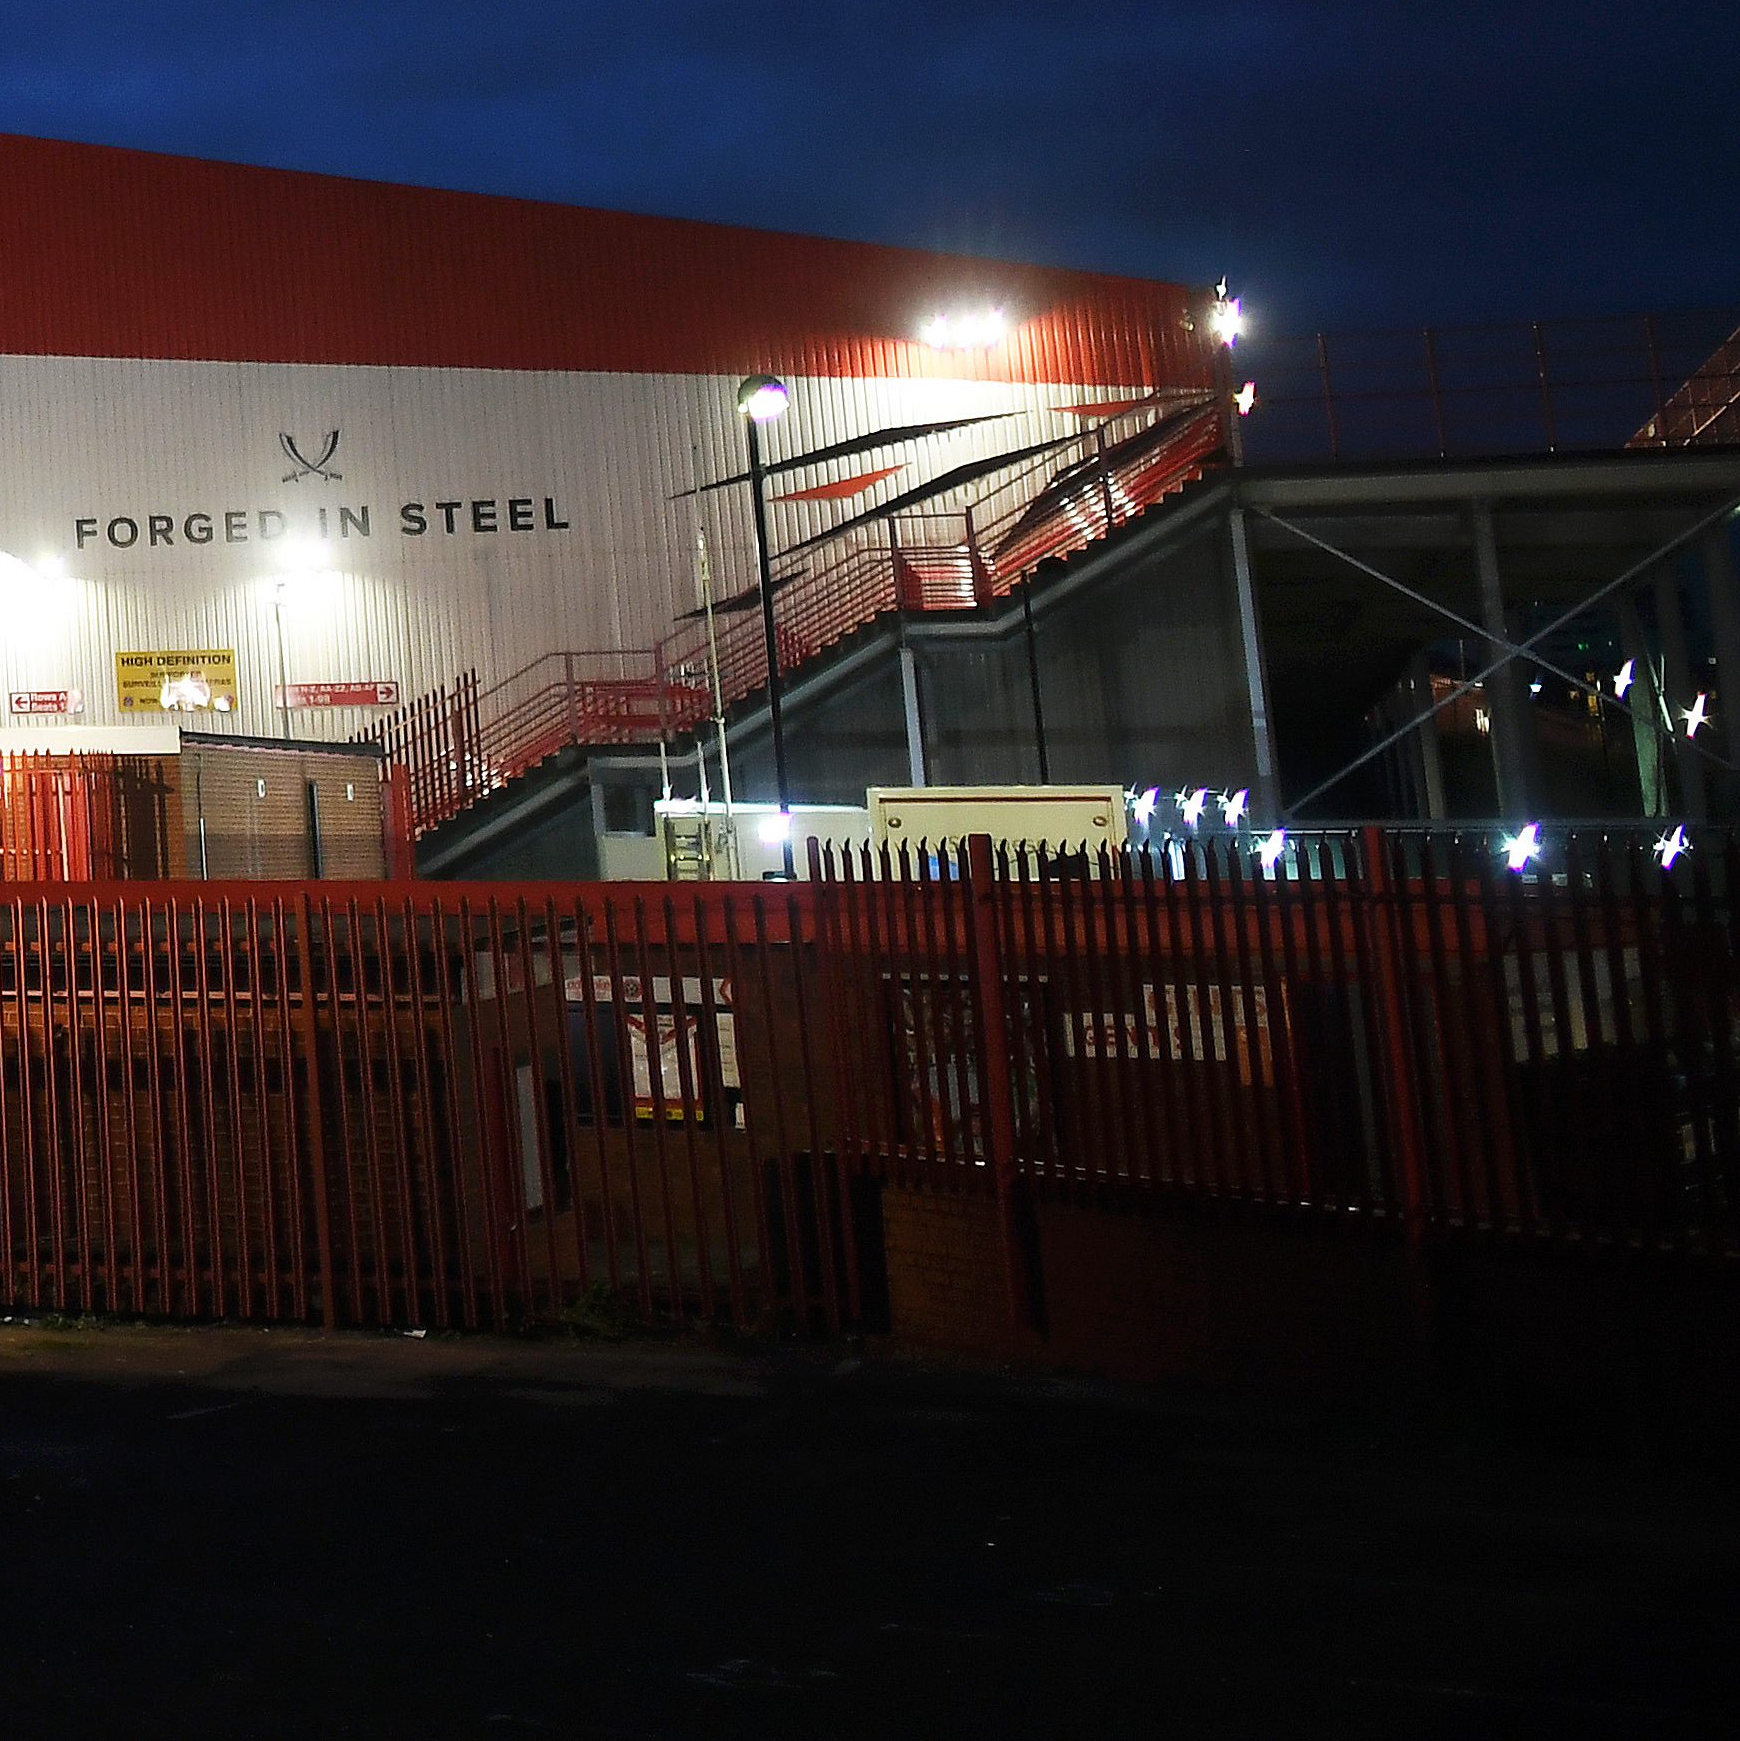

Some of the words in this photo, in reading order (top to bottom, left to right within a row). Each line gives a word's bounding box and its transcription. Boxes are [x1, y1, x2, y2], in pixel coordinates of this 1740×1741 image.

[74, 509, 289, 550] FORGED
[319, 505, 371, 539] IN
[400, 496, 570, 538] STEEL
[121, 656, 153, 667] HIGH
[157, 655, 231, 666] DEFINITION
